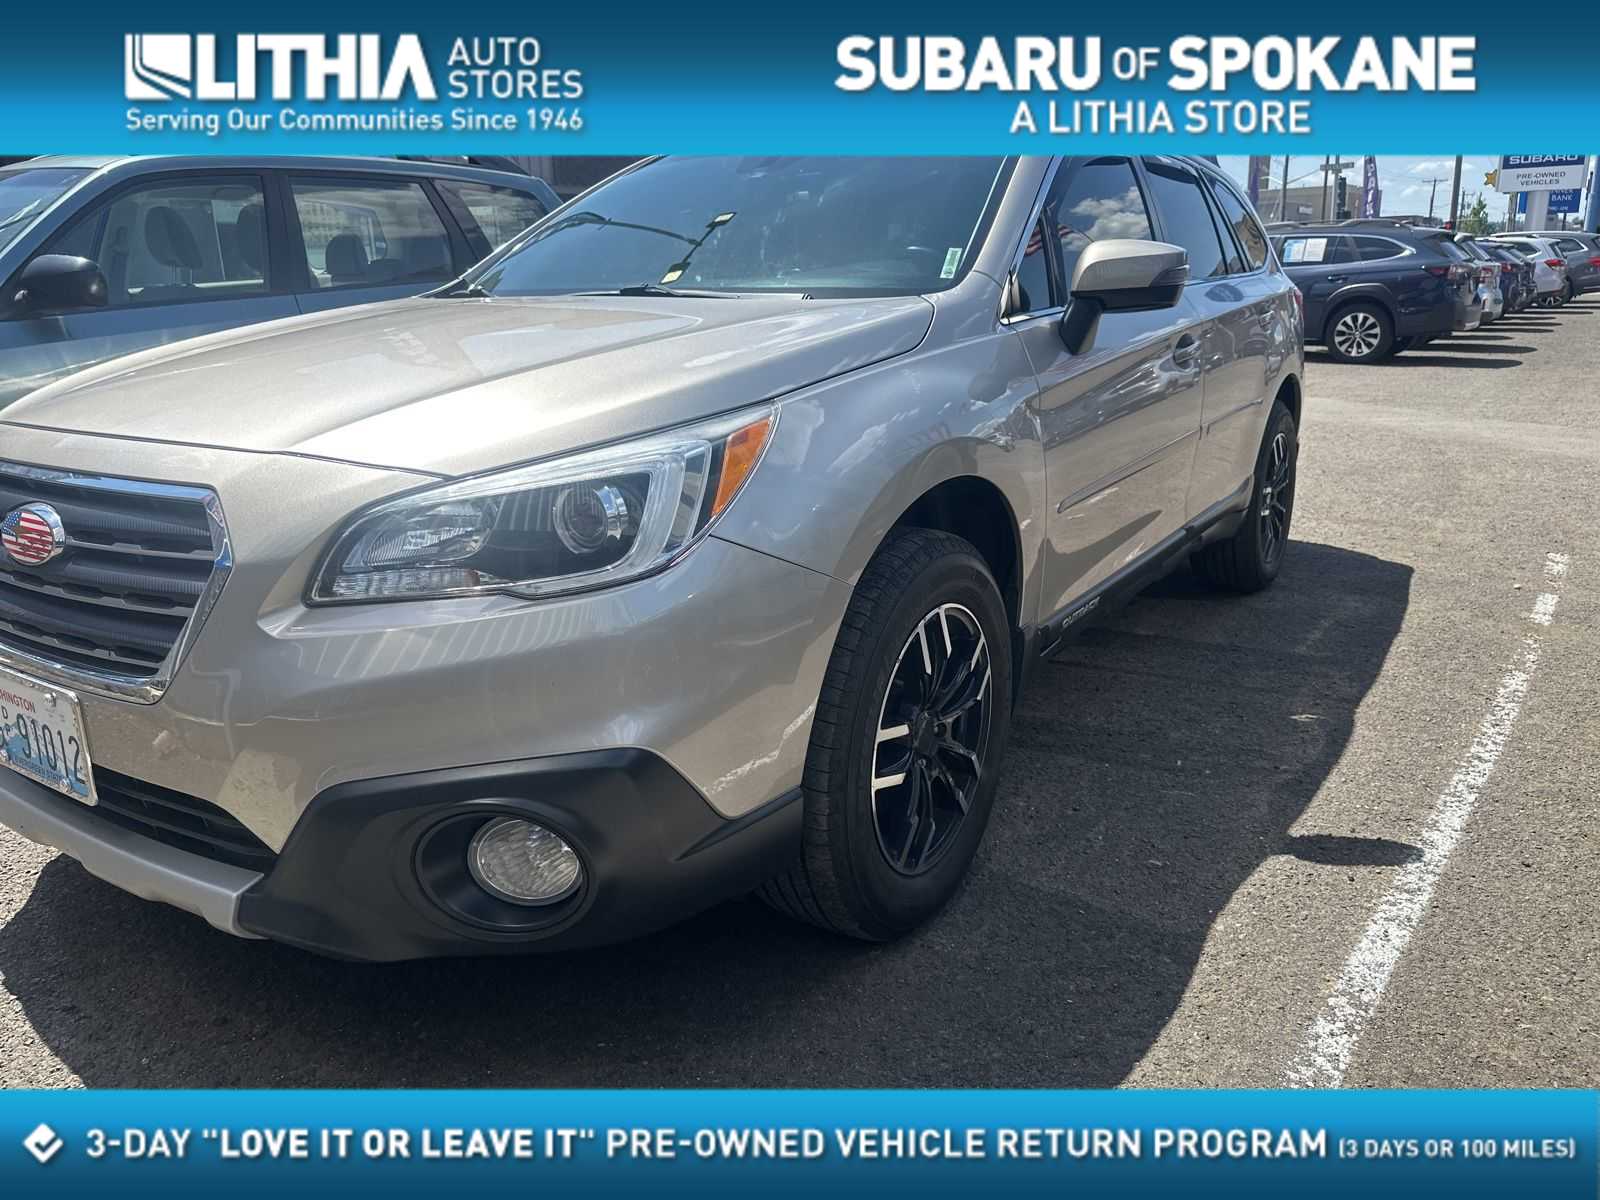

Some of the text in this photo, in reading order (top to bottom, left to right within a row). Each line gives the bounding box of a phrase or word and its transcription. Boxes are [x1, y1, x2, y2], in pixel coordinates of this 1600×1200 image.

[1516, 171, 1566, 180] PRE-OWNED
[1551, 194, 1573, 202] BANK
[16, 713, 86, 785] 91012
